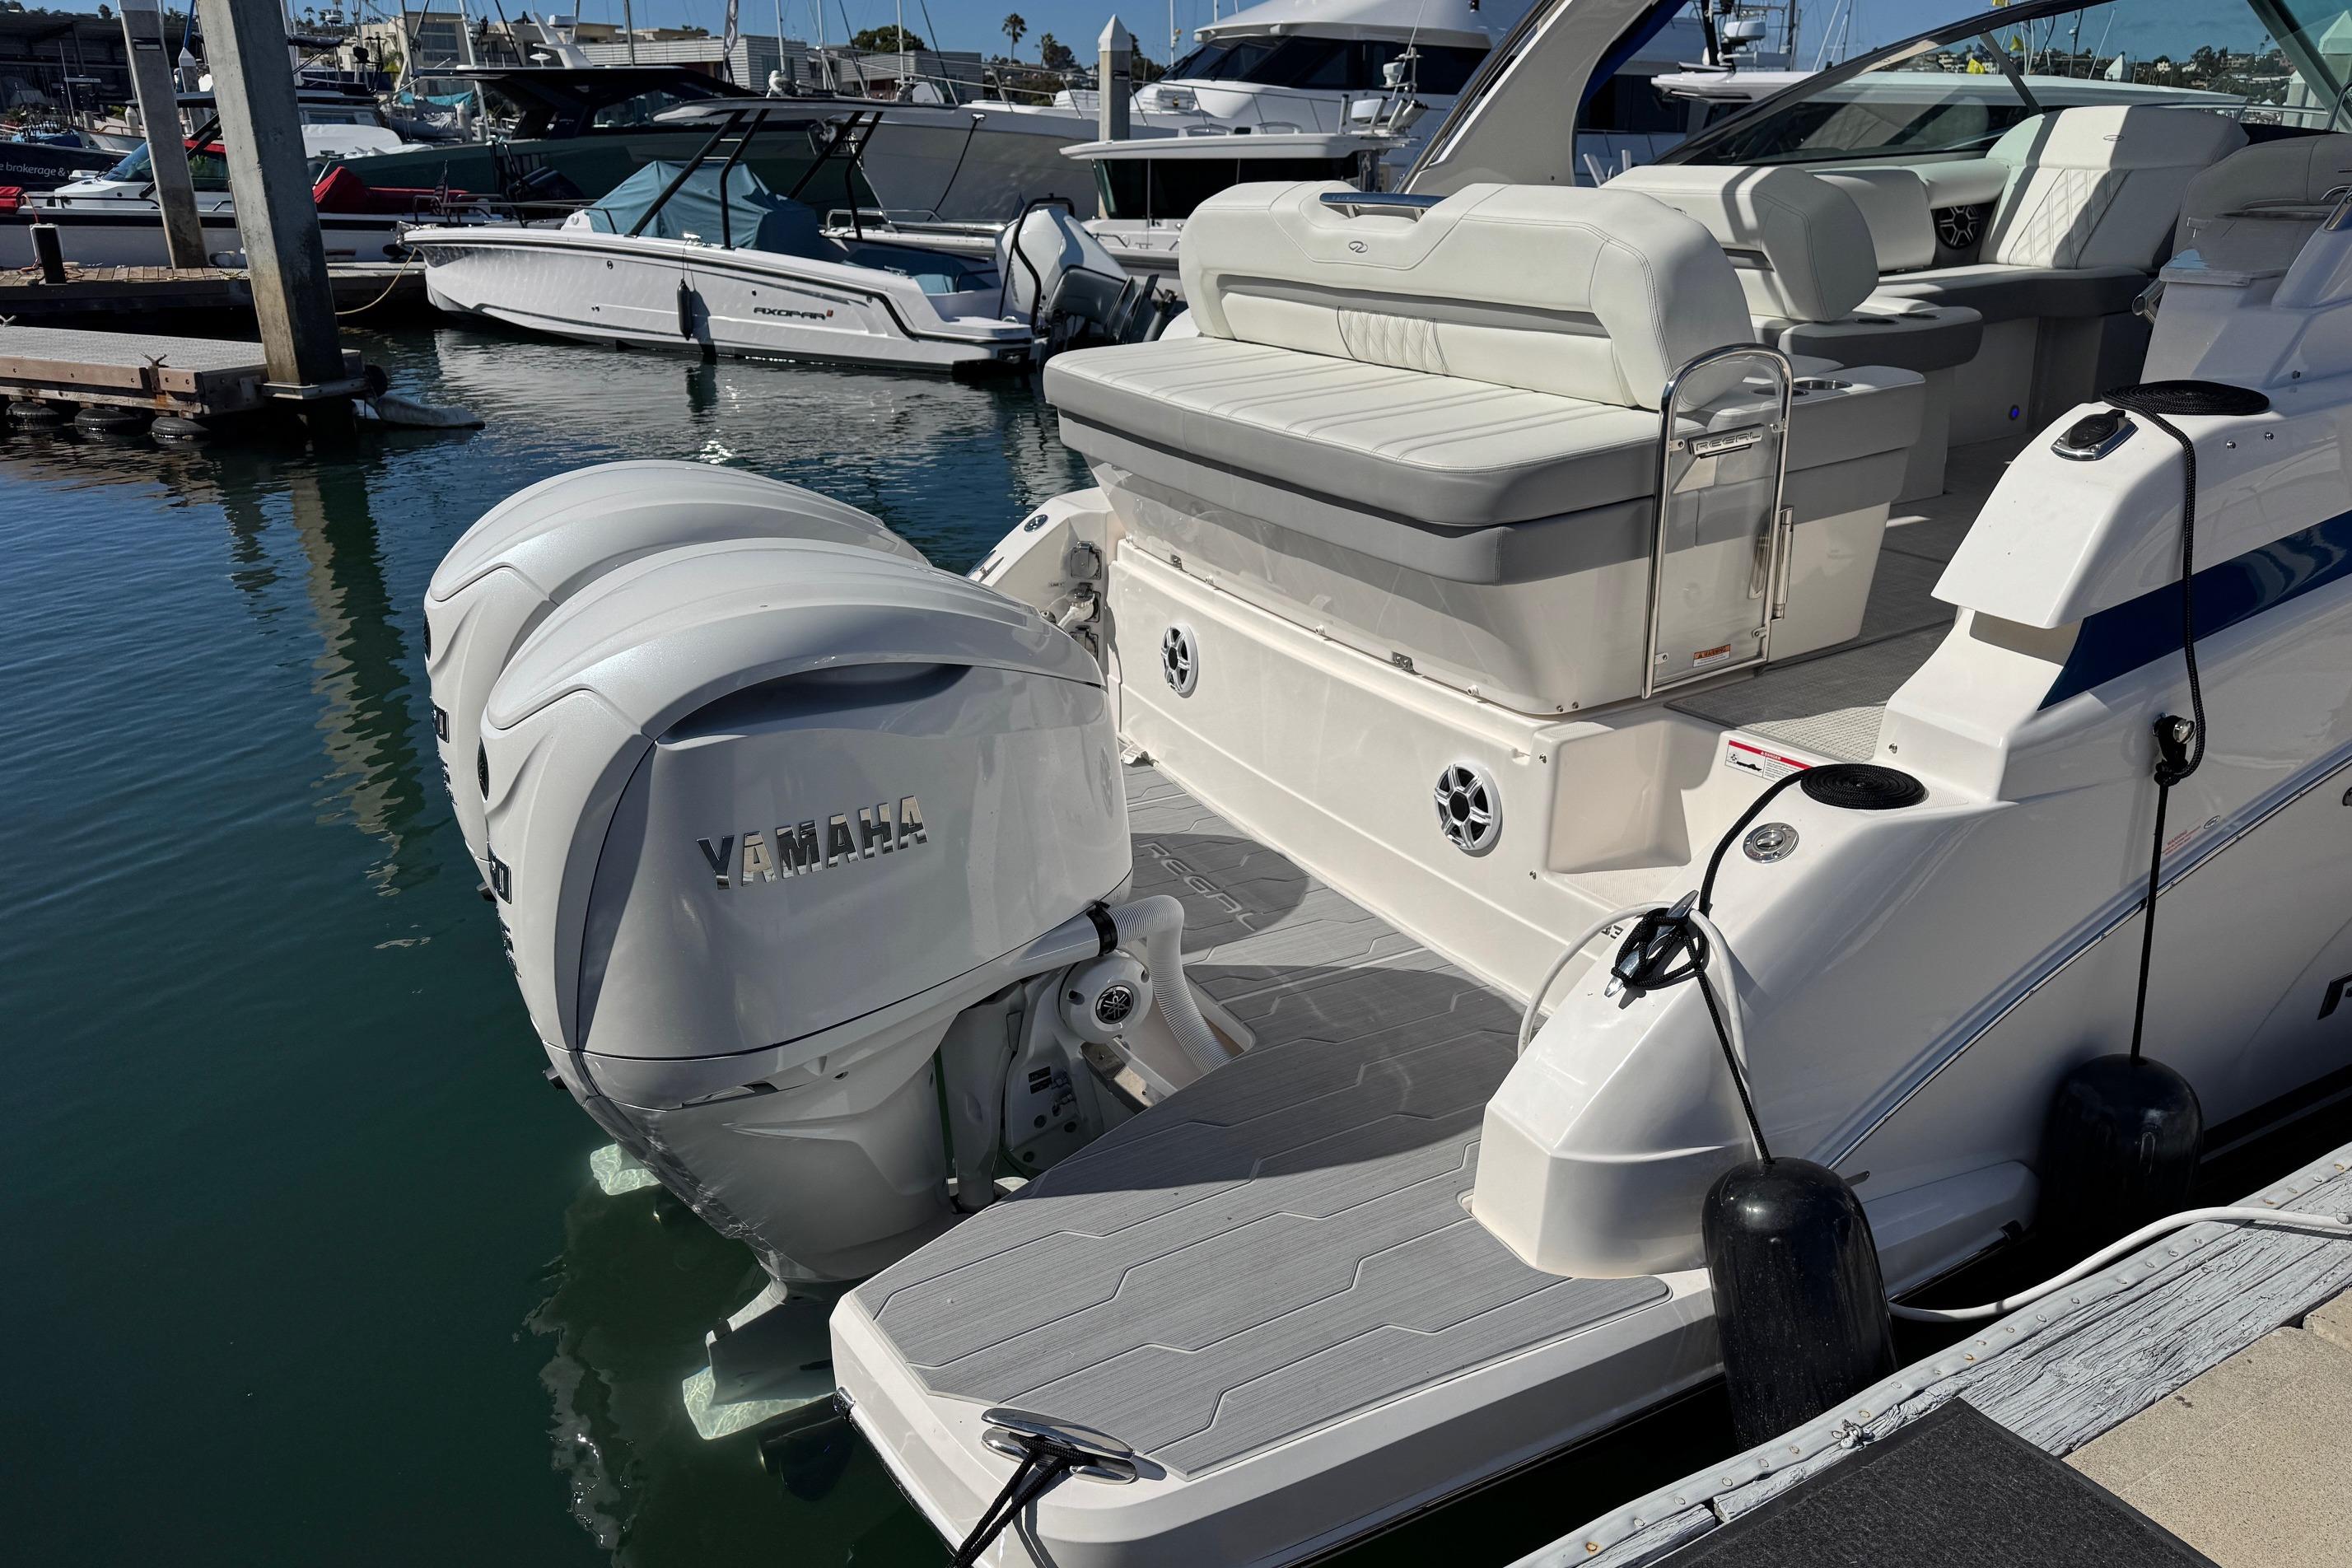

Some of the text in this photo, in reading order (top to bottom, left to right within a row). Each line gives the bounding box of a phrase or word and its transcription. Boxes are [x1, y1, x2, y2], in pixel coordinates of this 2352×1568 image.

[6, 161, 57, 178] brokerage
[58, 167, 66, 177] &
[754, 306, 826, 321] AXOPAR
[1696, 432, 1762, 451] REGAL
[1764, 751, 1781, 761] DANGER
[697, 795, 929, 890] YAMAHA
[1136, 842, 1257, 932] REGAL
